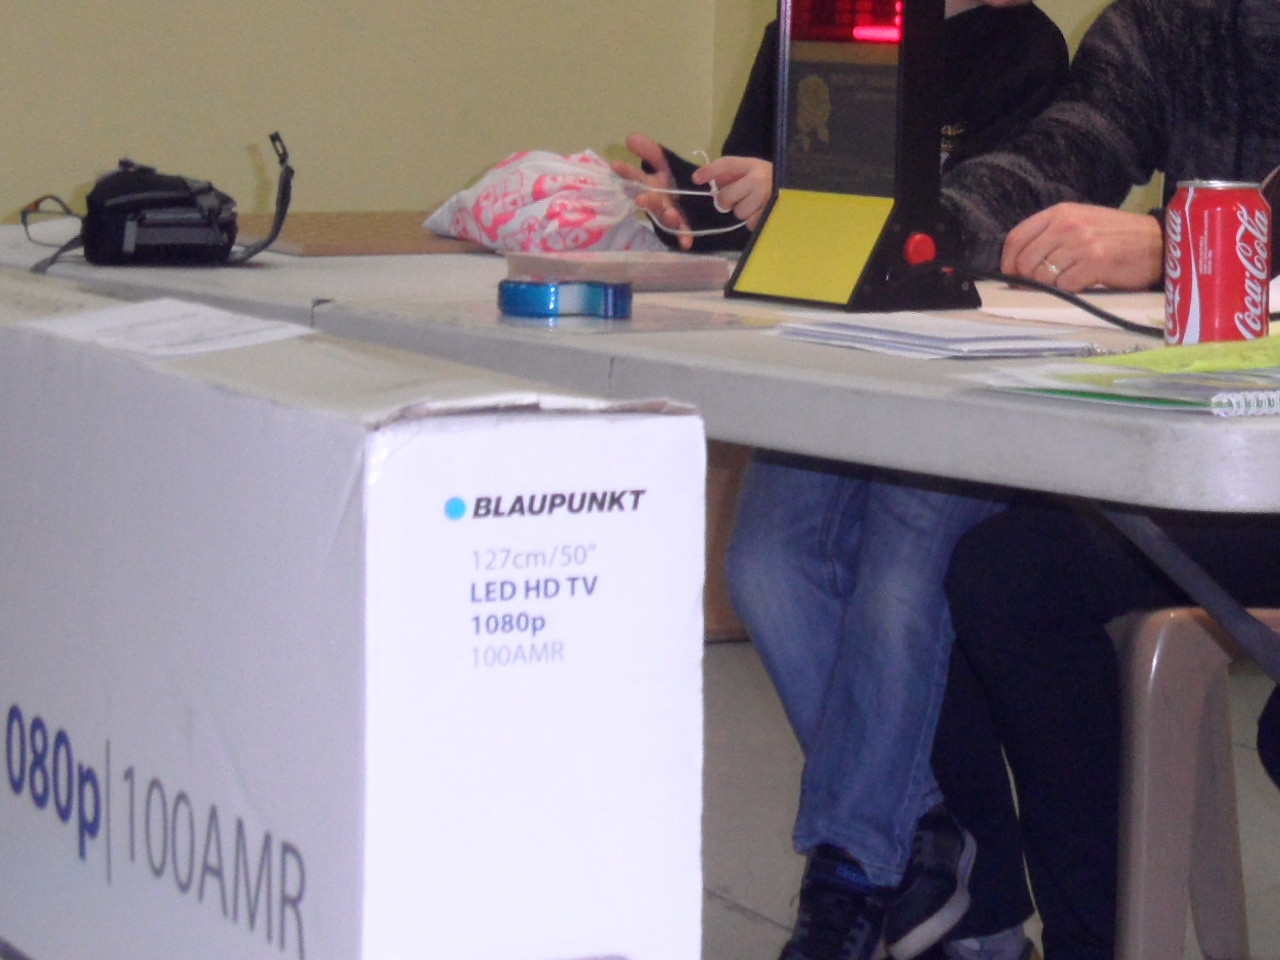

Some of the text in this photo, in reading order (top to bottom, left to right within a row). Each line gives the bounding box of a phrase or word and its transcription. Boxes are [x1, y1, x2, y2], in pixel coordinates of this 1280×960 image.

[472, 489, 647, 519] BLAUPUNKT
[470, 575, 598, 603] LED HD TV
[472, 612, 546, 638] 1080p
[471, 640, 565, 668] 100AMR
[123, 765, 306, 960] 100AMR
